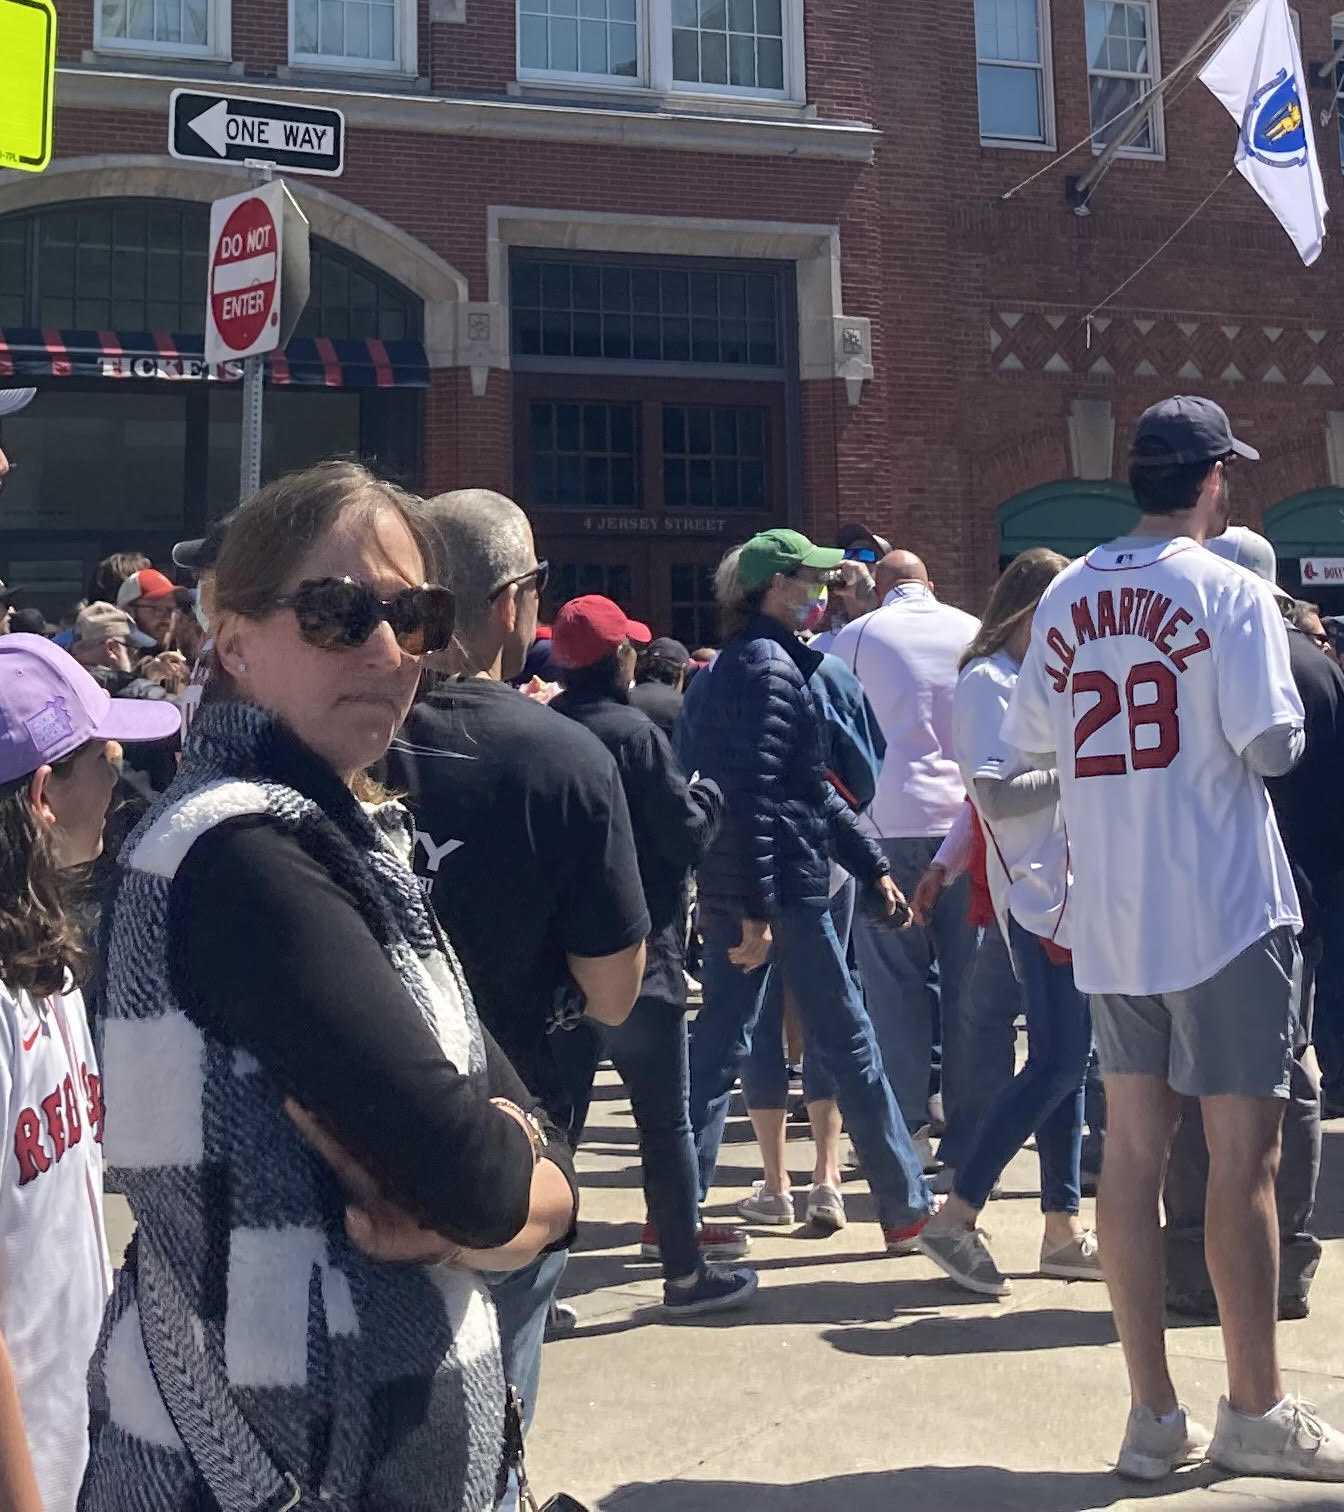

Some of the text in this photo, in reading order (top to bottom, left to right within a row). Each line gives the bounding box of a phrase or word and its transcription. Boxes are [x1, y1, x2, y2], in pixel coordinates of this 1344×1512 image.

[226, 118, 328, 150] ONE WAY
[221, 224, 272, 259] DO NOT
[222, 290, 265, 320] ENTER
[97, 357, 244, 381] TICKETS
[583, 517, 726, 531] 4 JERSEY STREET
[1070, 587, 1211, 674] MARTINEZ
[1072, 660, 1181, 779] 28
[14, 1071, 82, 1186] RED
